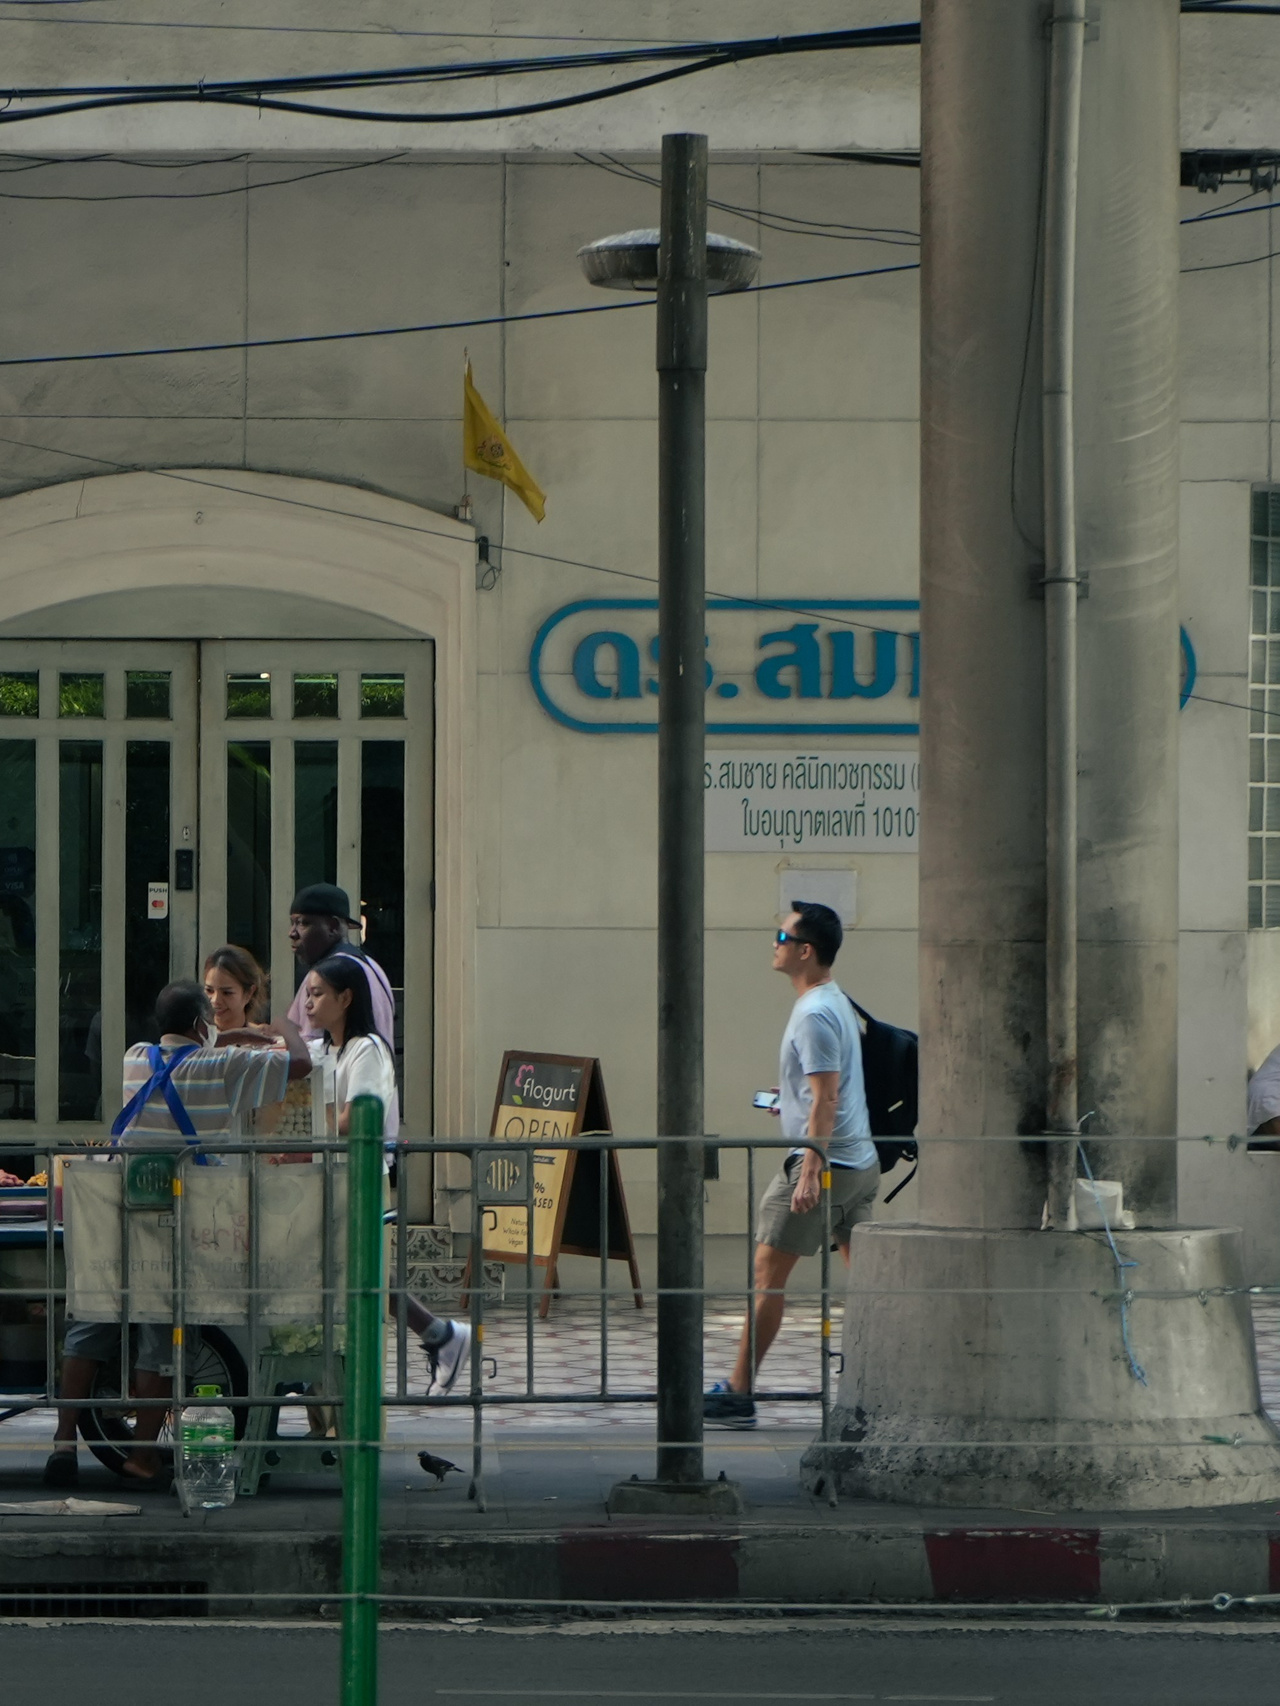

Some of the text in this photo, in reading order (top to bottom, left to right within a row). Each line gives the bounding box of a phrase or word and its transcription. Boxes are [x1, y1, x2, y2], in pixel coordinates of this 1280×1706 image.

[704, 760, 776, 790] ร.สมชาย
[783, 756, 905, 790] คลินิกเวชกรรม
[741, 792, 920, 849] ใบอนุญาตเลขที่ 1010
[522, 1077, 576, 1108] flogurt
[504, 1116, 569, 1142] OPEN
